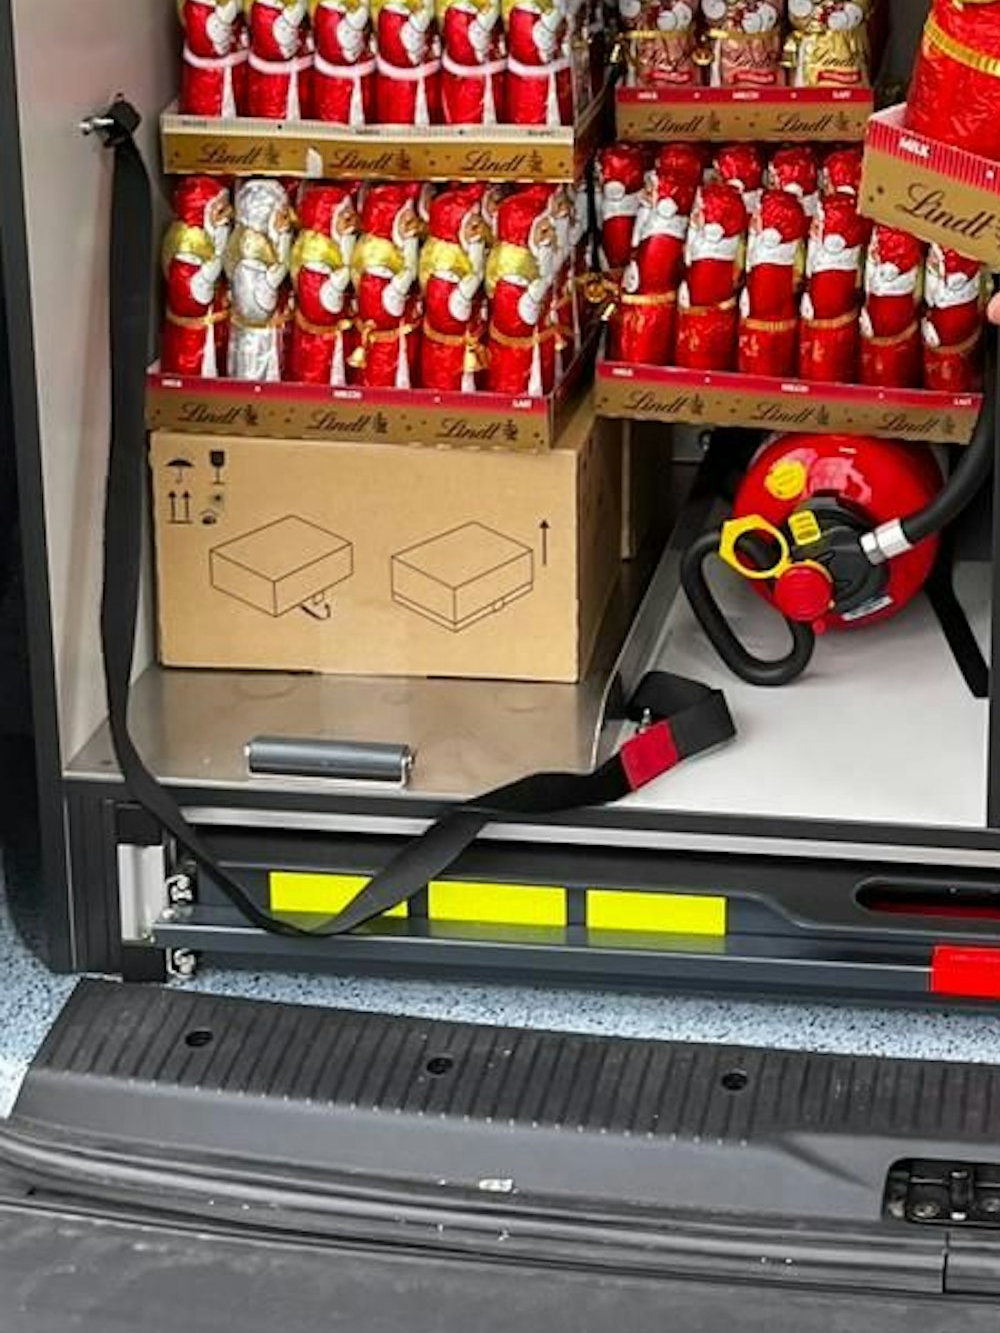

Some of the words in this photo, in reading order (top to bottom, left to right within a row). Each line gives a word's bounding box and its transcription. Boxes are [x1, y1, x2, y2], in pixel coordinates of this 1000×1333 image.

[642, 112, 707, 134] Lindt
[770, 112, 832, 132] Lindt
[197, 142, 262, 165] Lindt
[329, 148, 393, 170] Lindt
[461, 149, 527, 172] Lindt
[899, 136, 930, 158] MILK
[895, 182, 995, 240] Lindt
[177, 402, 240, 424] Lindt
[305, 410, 371, 432] Lindt
[435, 418, 500, 440] Lindt
[625, 390, 690, 413] Lindt
[750, 402, 816, 423] Lindt
[876, 412, 940, 434] Lindt
